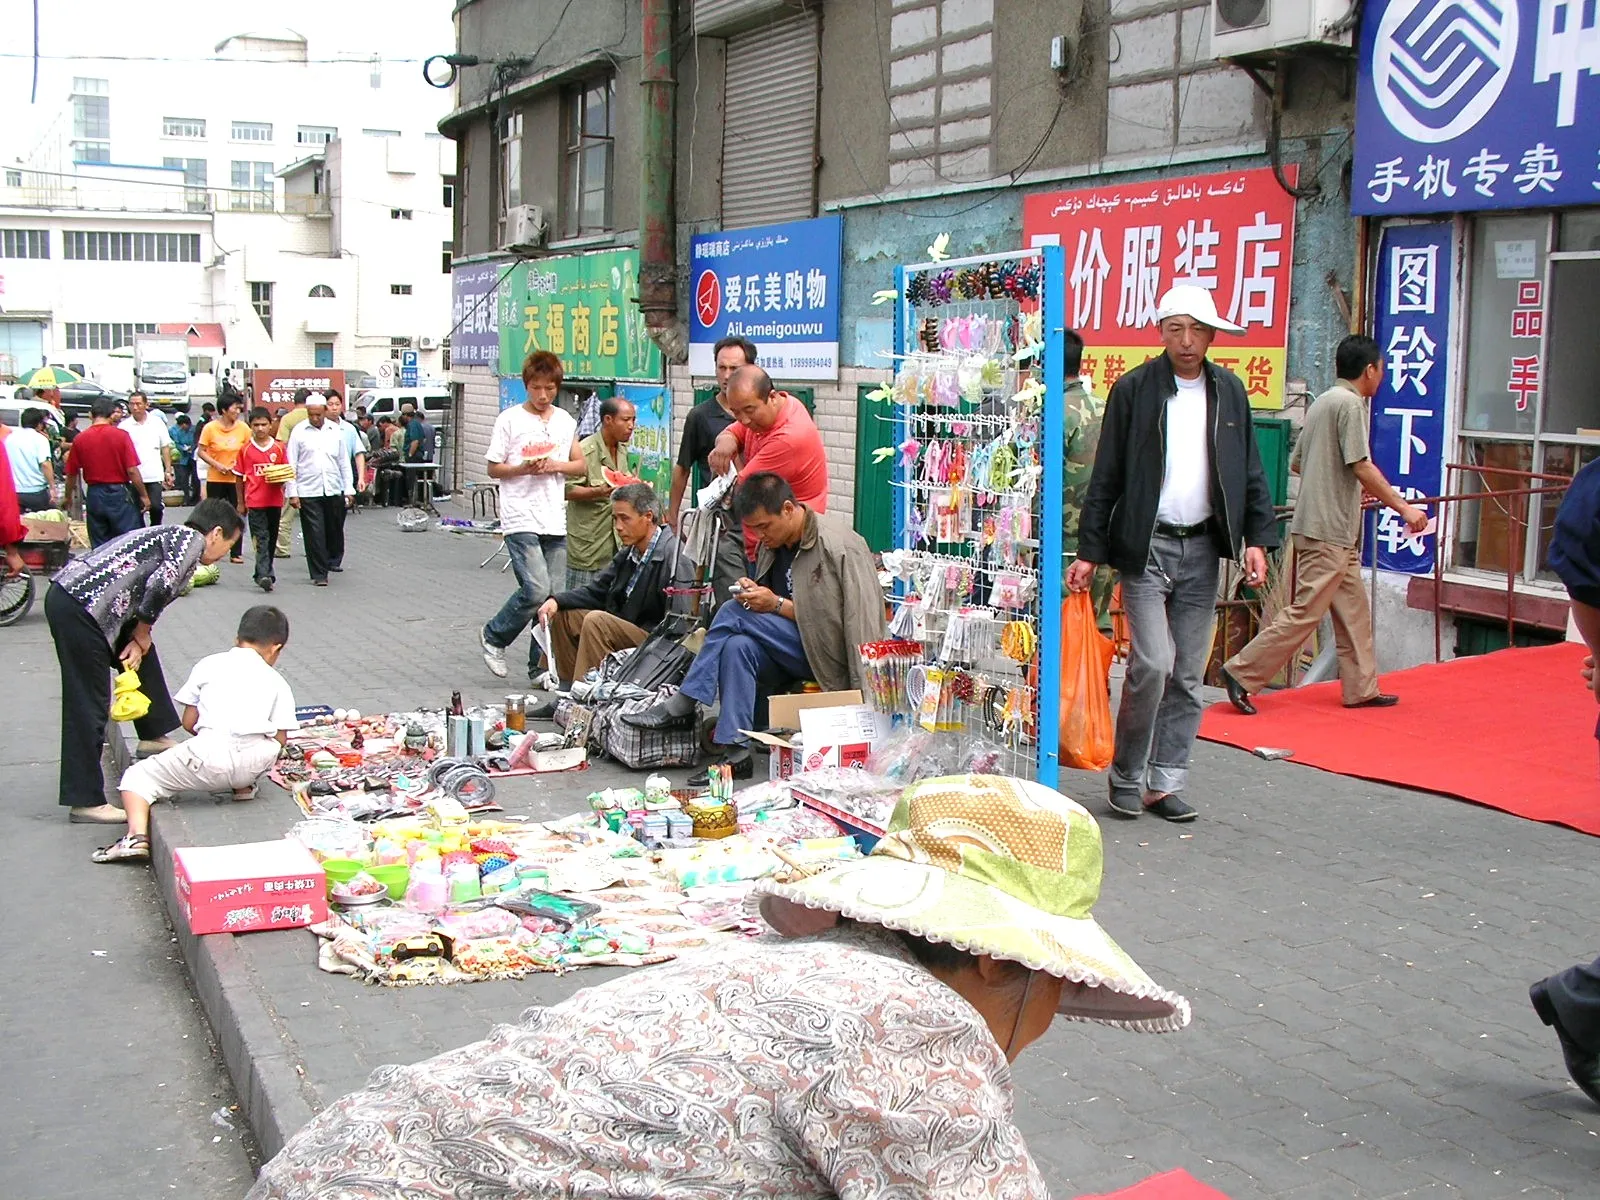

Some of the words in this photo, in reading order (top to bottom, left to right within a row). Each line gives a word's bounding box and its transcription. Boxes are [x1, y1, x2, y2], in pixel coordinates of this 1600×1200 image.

[1367, 142, 1563, 203] 手机专卖
[724, 267, 827, 313] 爱乐美购物
[523, 298, 619, 357] 天福商店
[726, 320, 823, 339] AiLemeigouwu
[405, 352, 415, 365] P
[1376, 243, 1440, 558] 图铃下载
